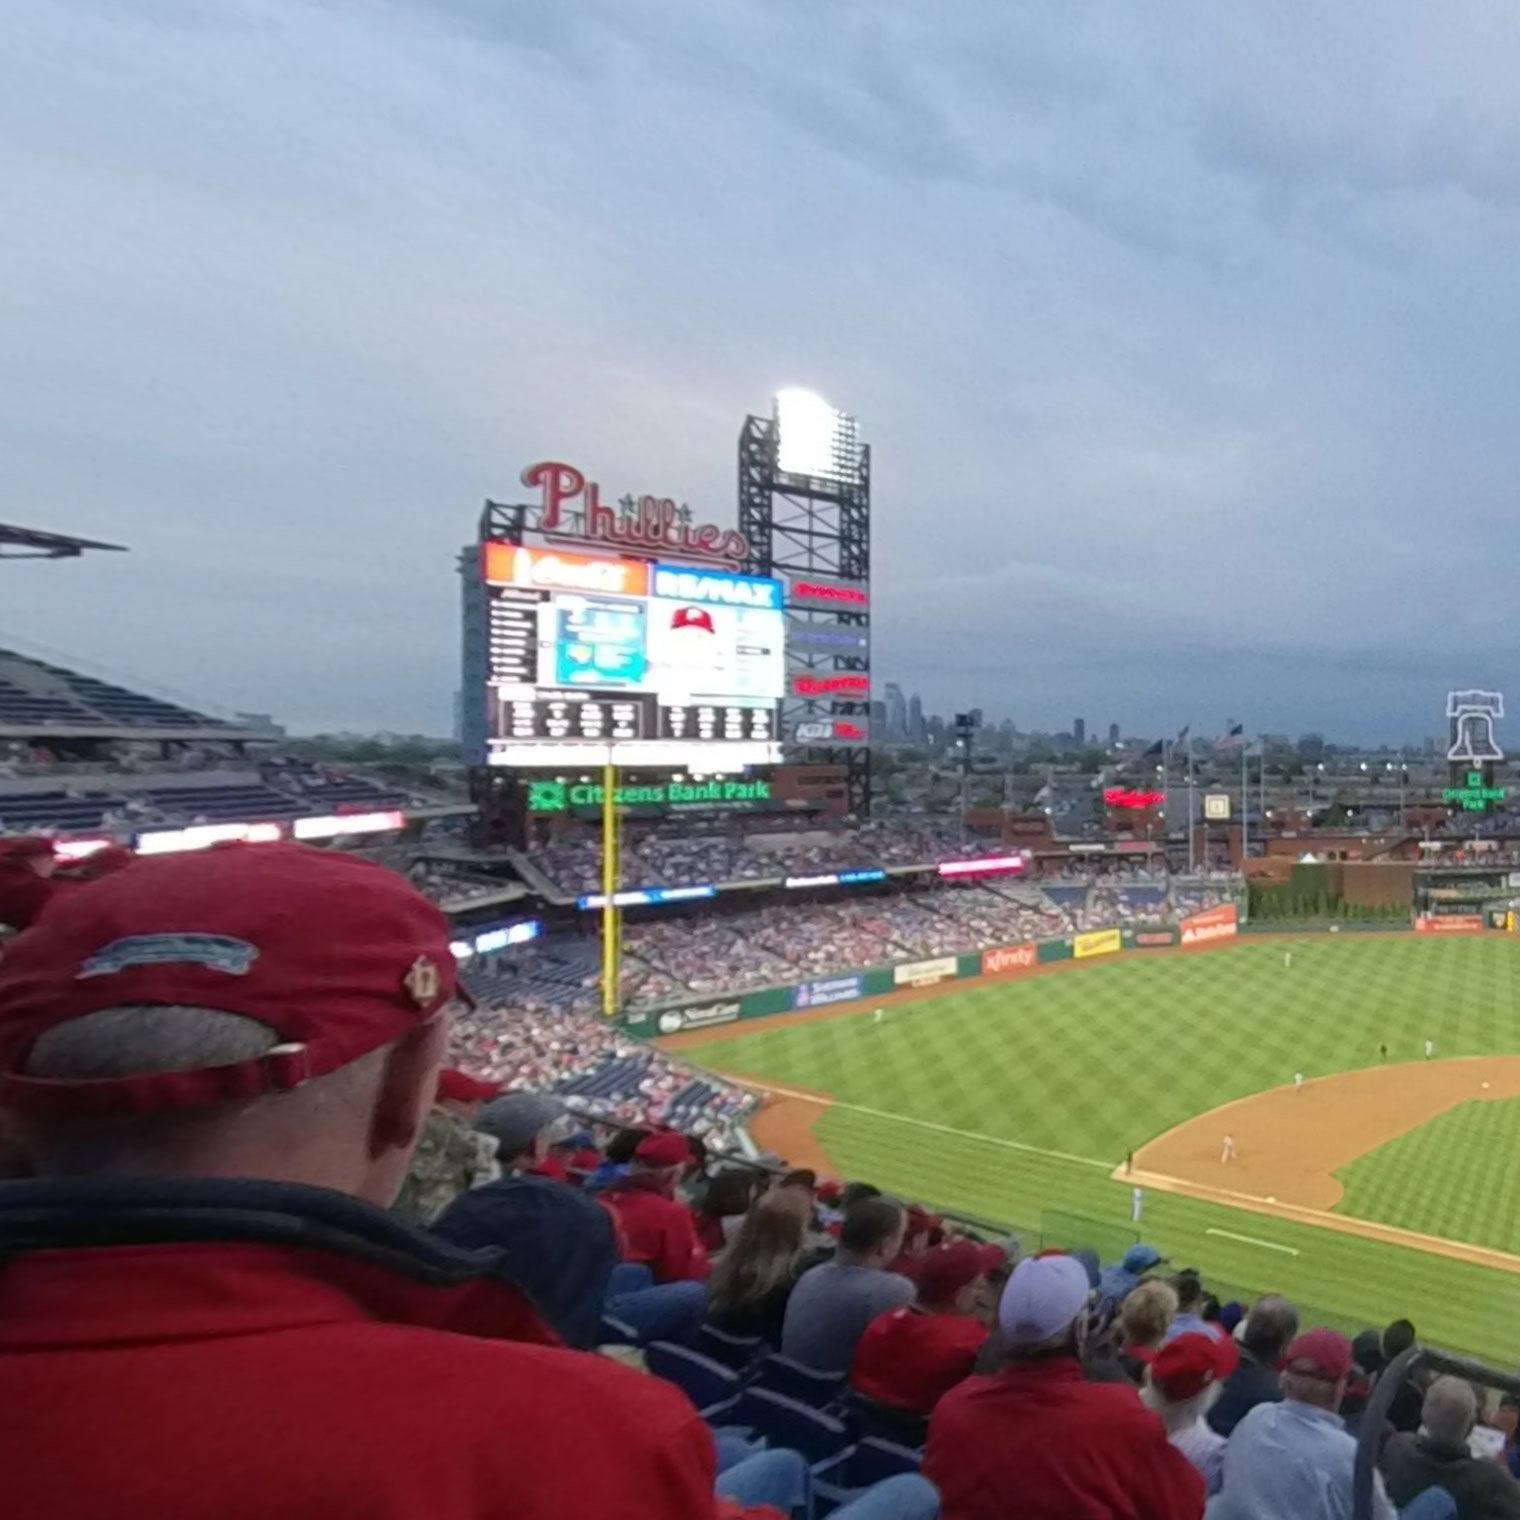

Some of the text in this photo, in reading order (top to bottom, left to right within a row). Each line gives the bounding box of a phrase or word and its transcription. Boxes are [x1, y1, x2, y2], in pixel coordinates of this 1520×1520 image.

[520, 461, 749, 559] Phillies
[655, 569, 774, 607] RE/MAX
[569, 780, 770, 804] Citzens Bank Park
[1463, 800, 1484, 810] Park
[986, 948, 1033, 971] xfinity
